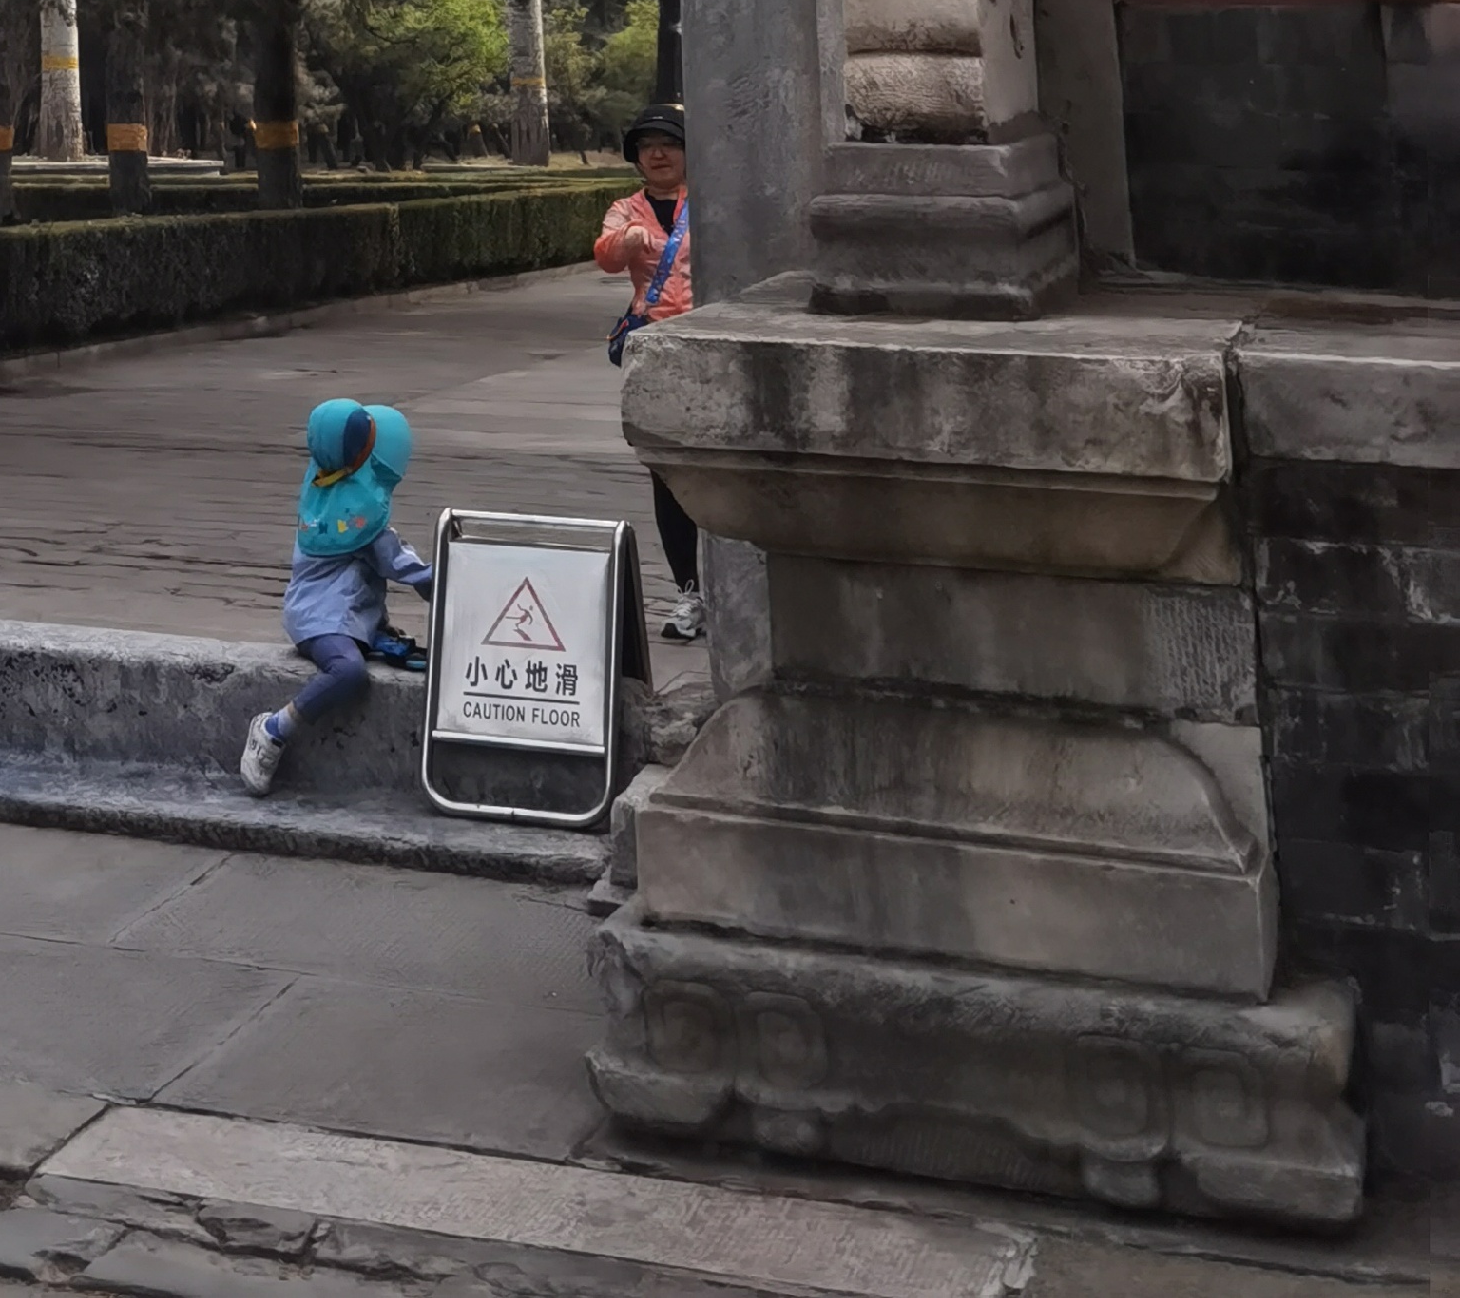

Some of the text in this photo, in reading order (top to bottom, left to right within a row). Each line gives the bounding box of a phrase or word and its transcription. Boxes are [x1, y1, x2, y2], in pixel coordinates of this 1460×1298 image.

[465, 656, 578, 696] 小心地滑
[463, 701, 580, 727] CAUTION FLOOR
